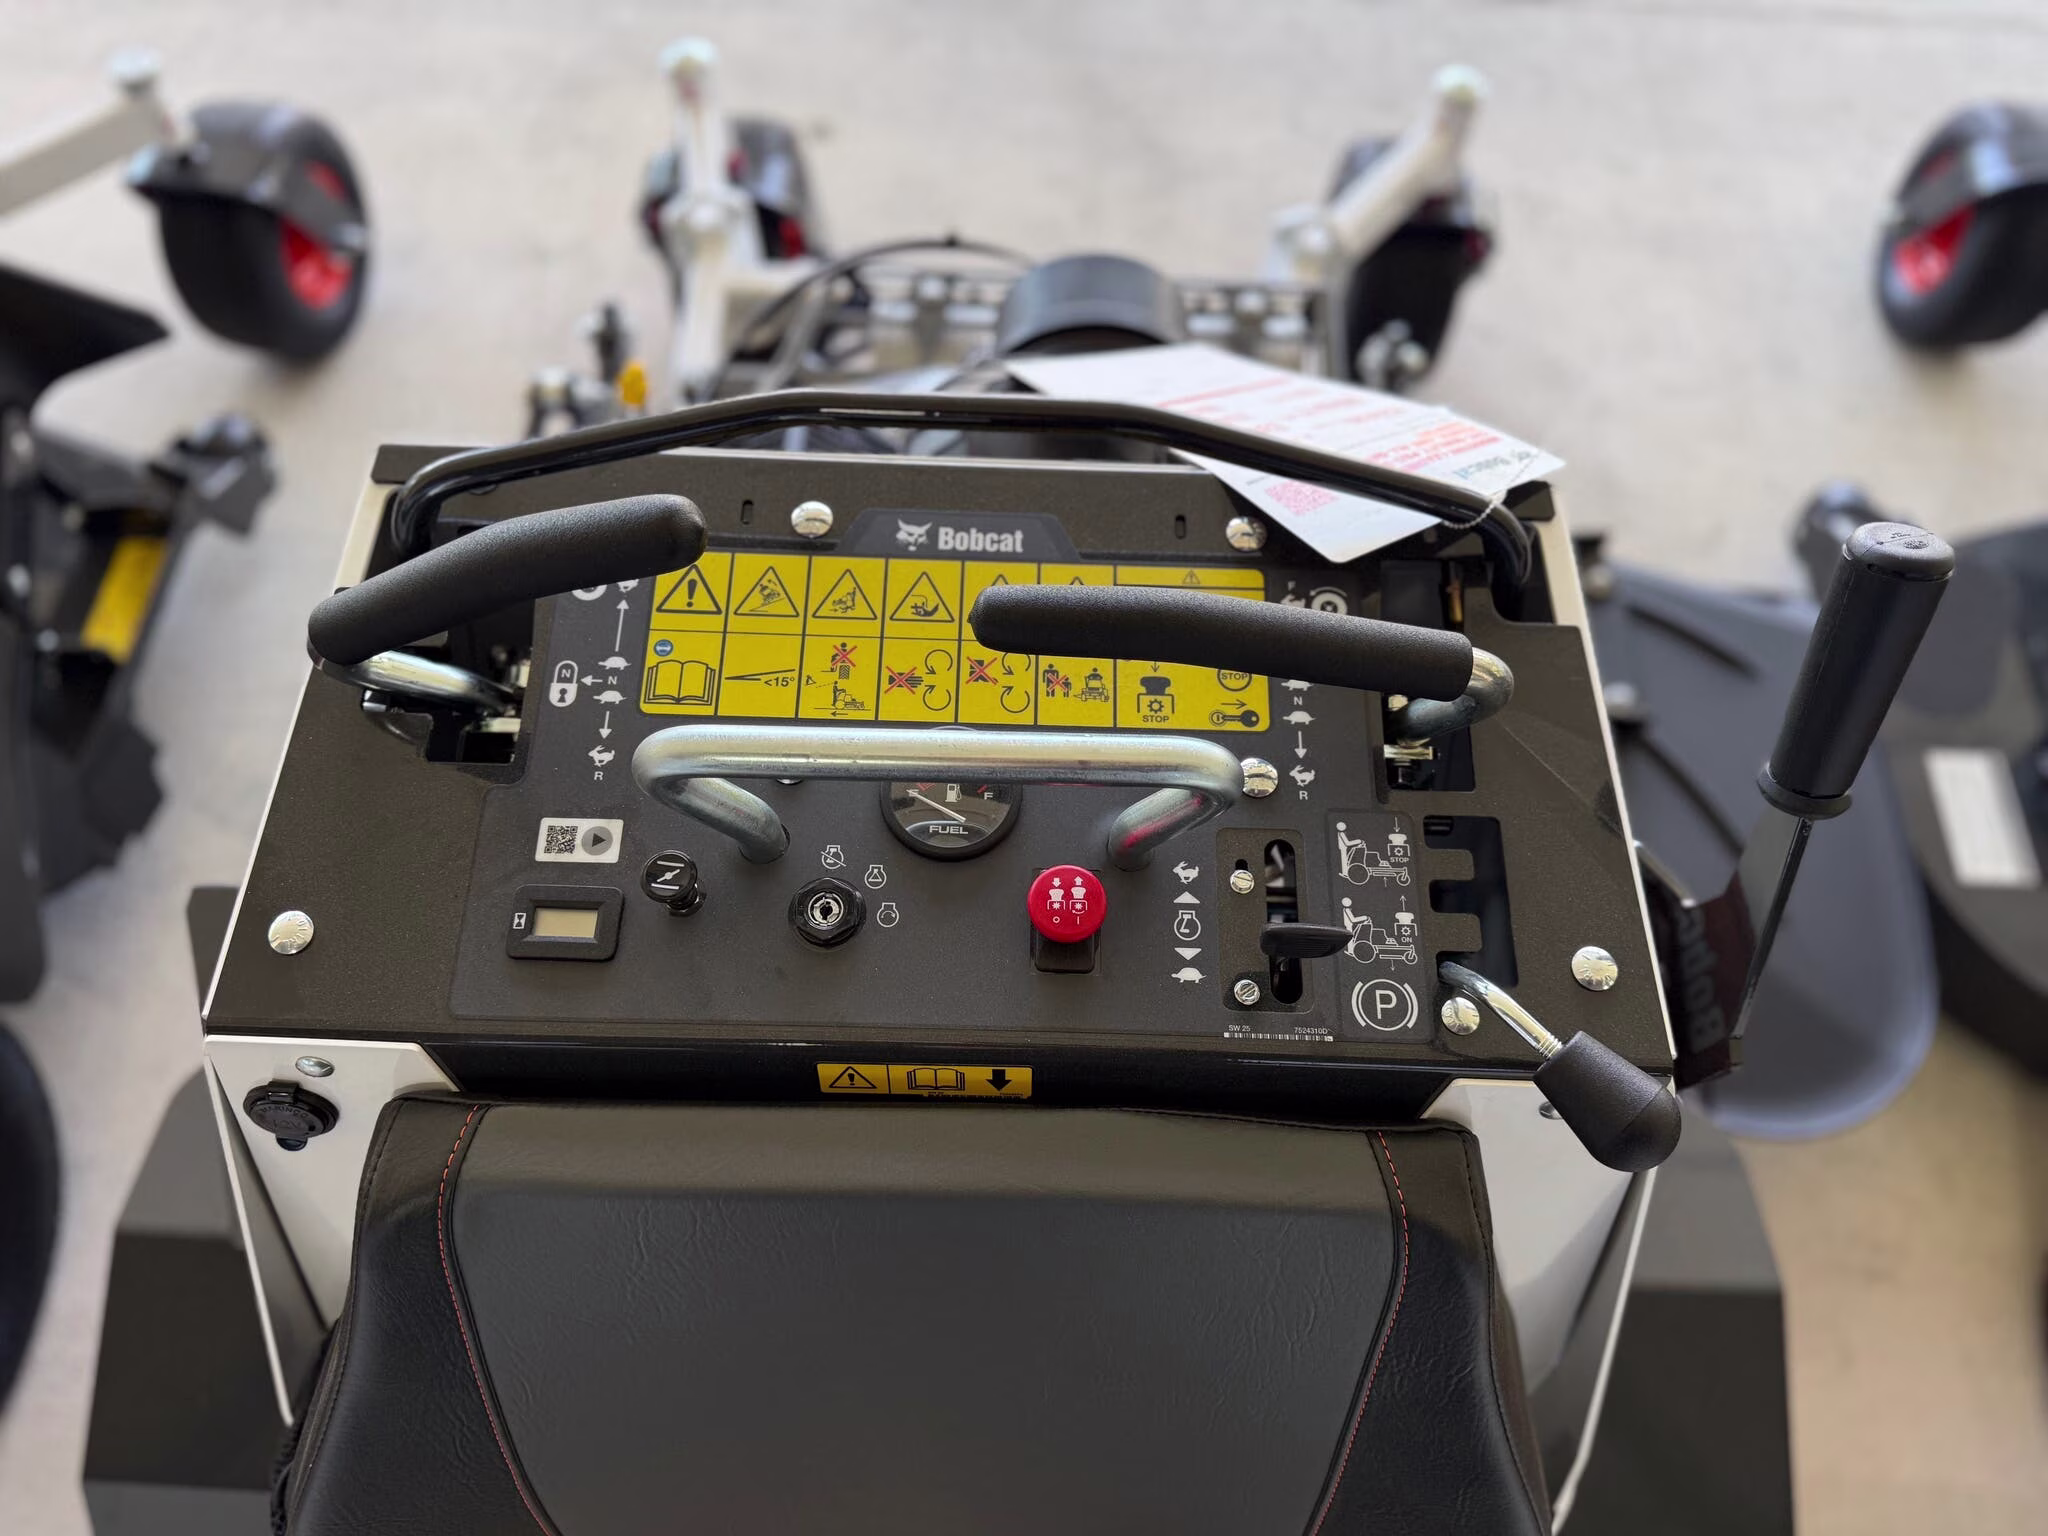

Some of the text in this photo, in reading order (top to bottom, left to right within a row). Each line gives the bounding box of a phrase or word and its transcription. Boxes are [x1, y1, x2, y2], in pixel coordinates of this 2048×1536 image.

[937, 526, 1024, 553] Bobcat
[561, 668, 571, 678] N
[1221, 672, 1249, 681] STOP
[607, 675, 618, 685] N
[1293, 696, 1303, 706] N
[1142, 714, 1170, 723] STOP
[593, 770, 604, 781] R
[983, 791, 994, 801] F
[1299, 790, 1309, 801] R
[928, 825, 969, 835] FUEL
[1375, 989, 1398, 1020] P
[1228, 1024, 1241, 1032] SW
